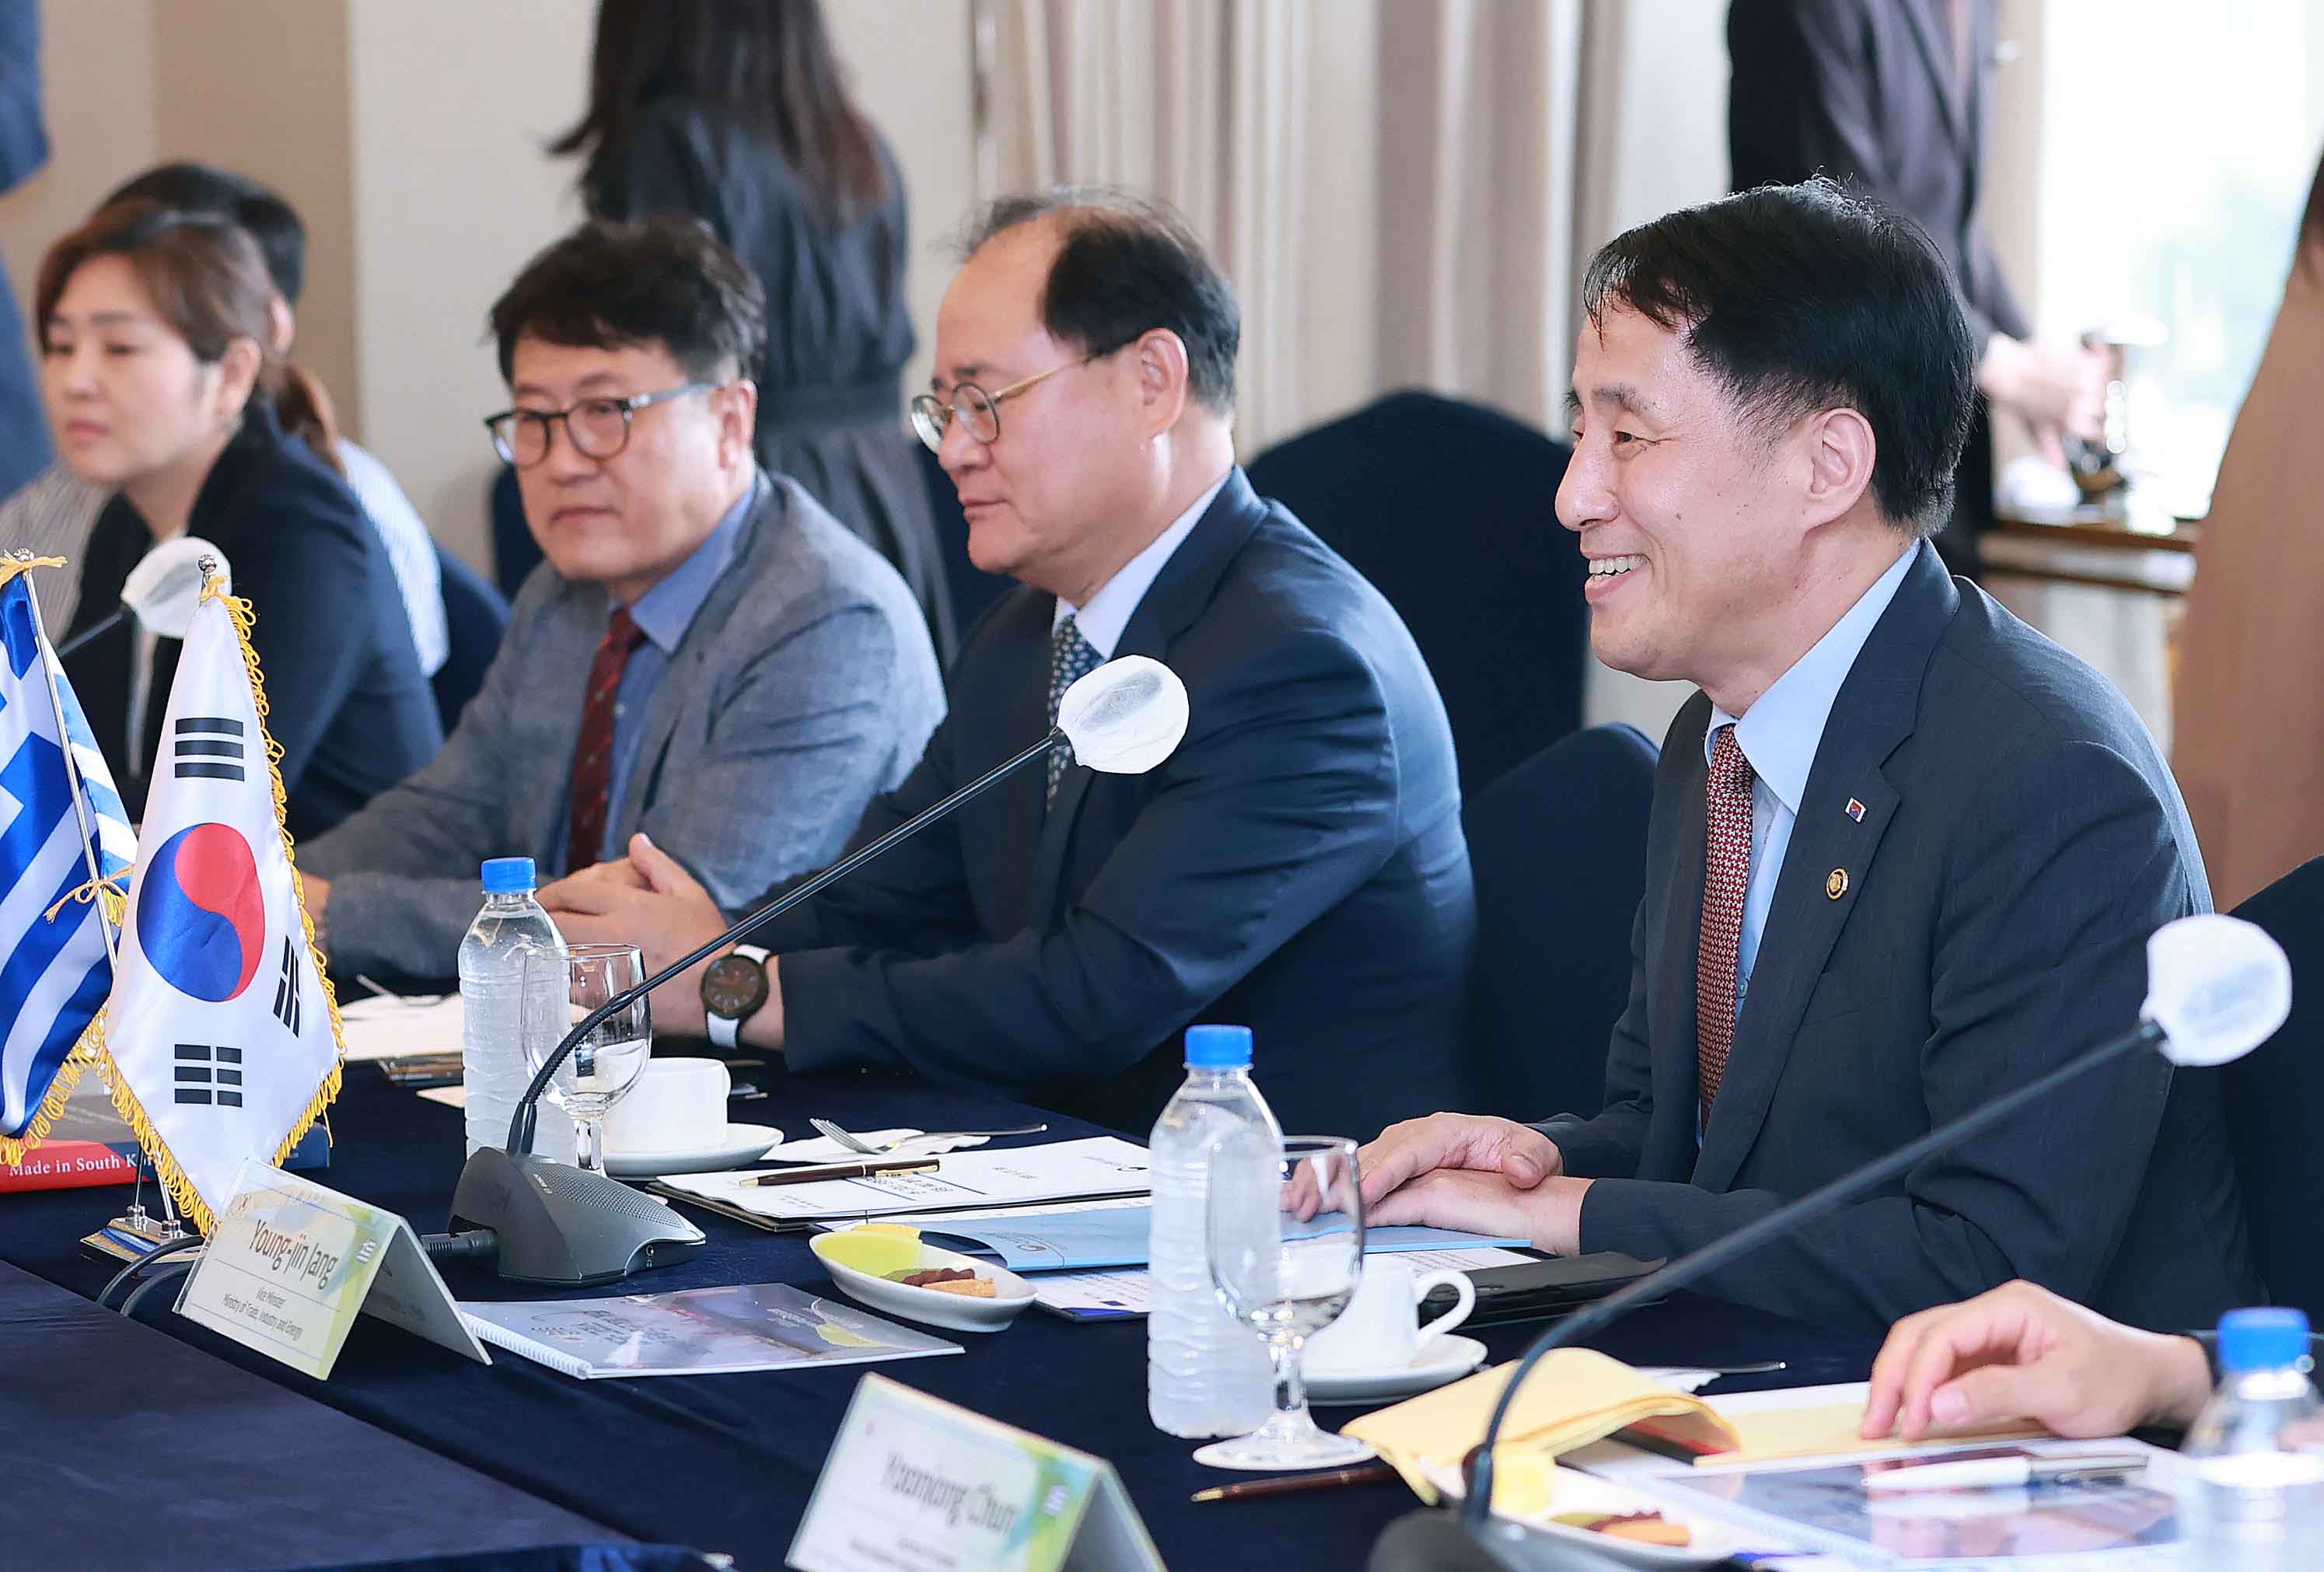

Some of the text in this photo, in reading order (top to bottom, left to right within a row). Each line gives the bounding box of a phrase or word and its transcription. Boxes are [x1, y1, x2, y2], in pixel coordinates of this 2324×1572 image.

[9, 1160, 51, 1176] Made
[56, 1159, 71, 1173] in
[75, 1154, 121, 1172] South
[250, 1219, 338, 1291] Young-jin Jang
